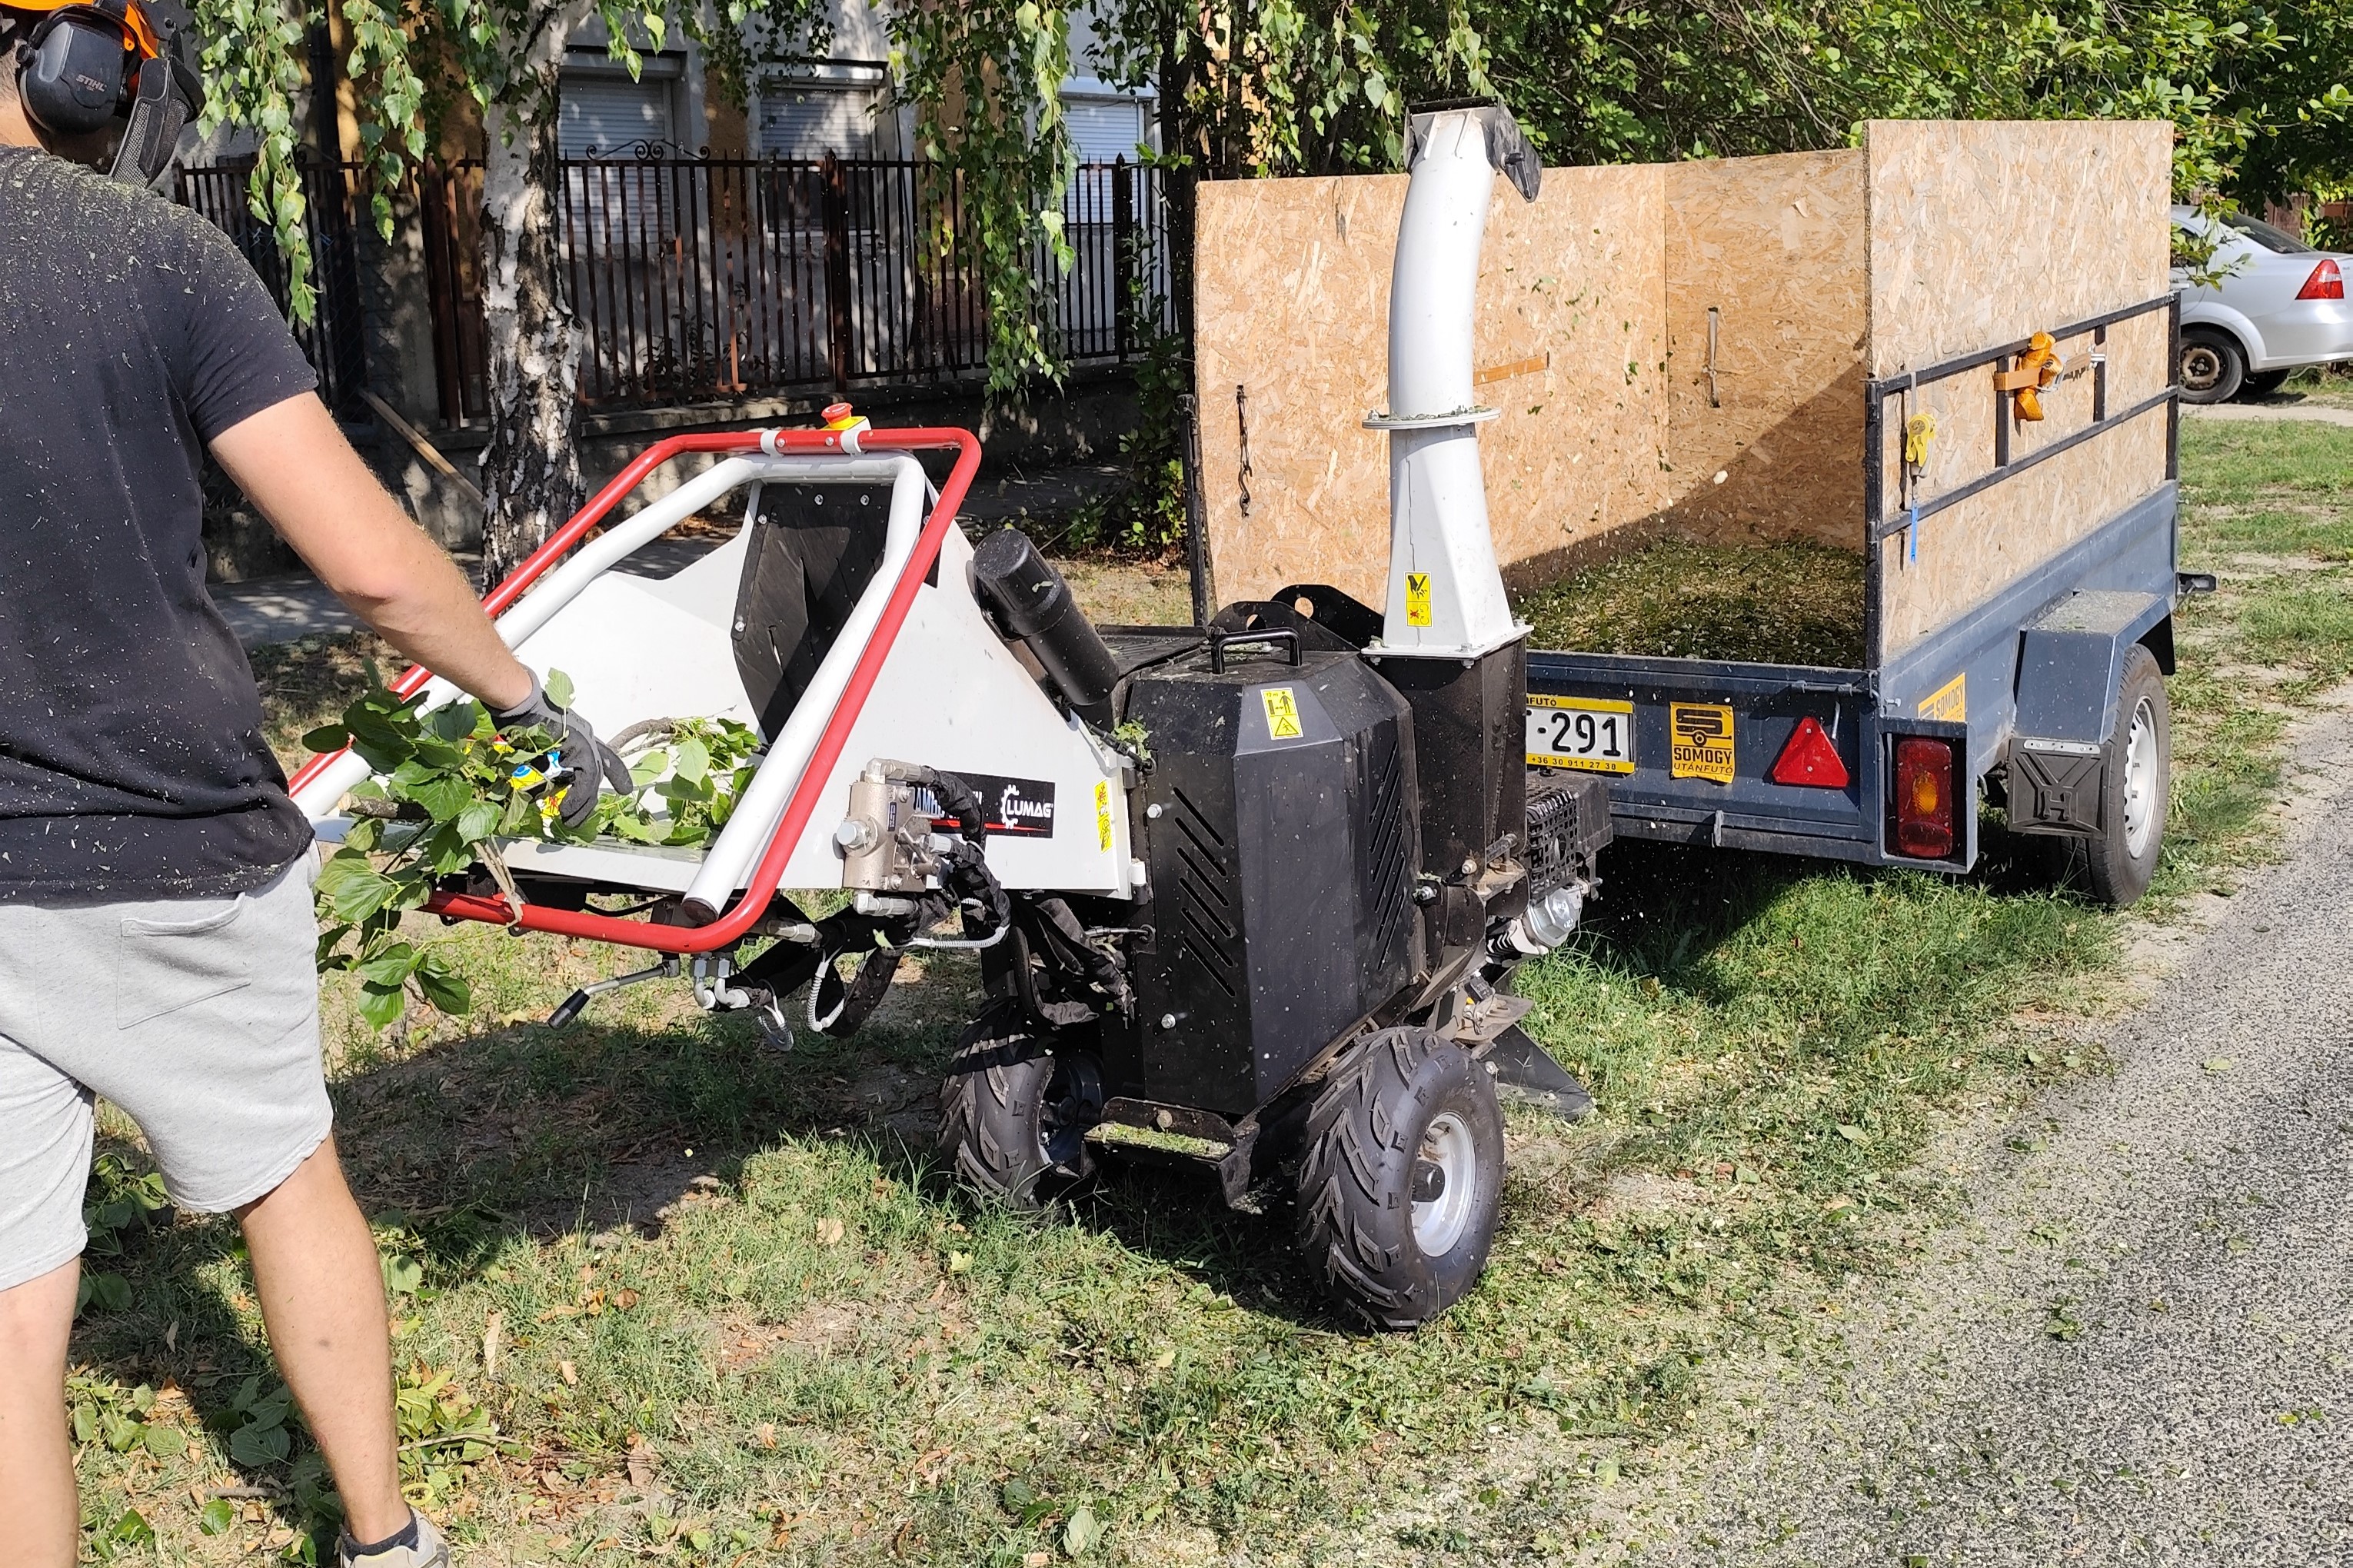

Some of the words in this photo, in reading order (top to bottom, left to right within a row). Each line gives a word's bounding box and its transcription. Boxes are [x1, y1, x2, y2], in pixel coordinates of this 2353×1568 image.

[76, 74, 105, 92] STIHL
[1936, 682, 1963, 720] SOMOGY
[1526, 710, 1622, 757] -291
[1673, 747, 1732, 764] SOMOGY
[1673, 762, 1733, 774] UTÁNFUTÓ
[1007, 799, 1052, 818] LUMAG
